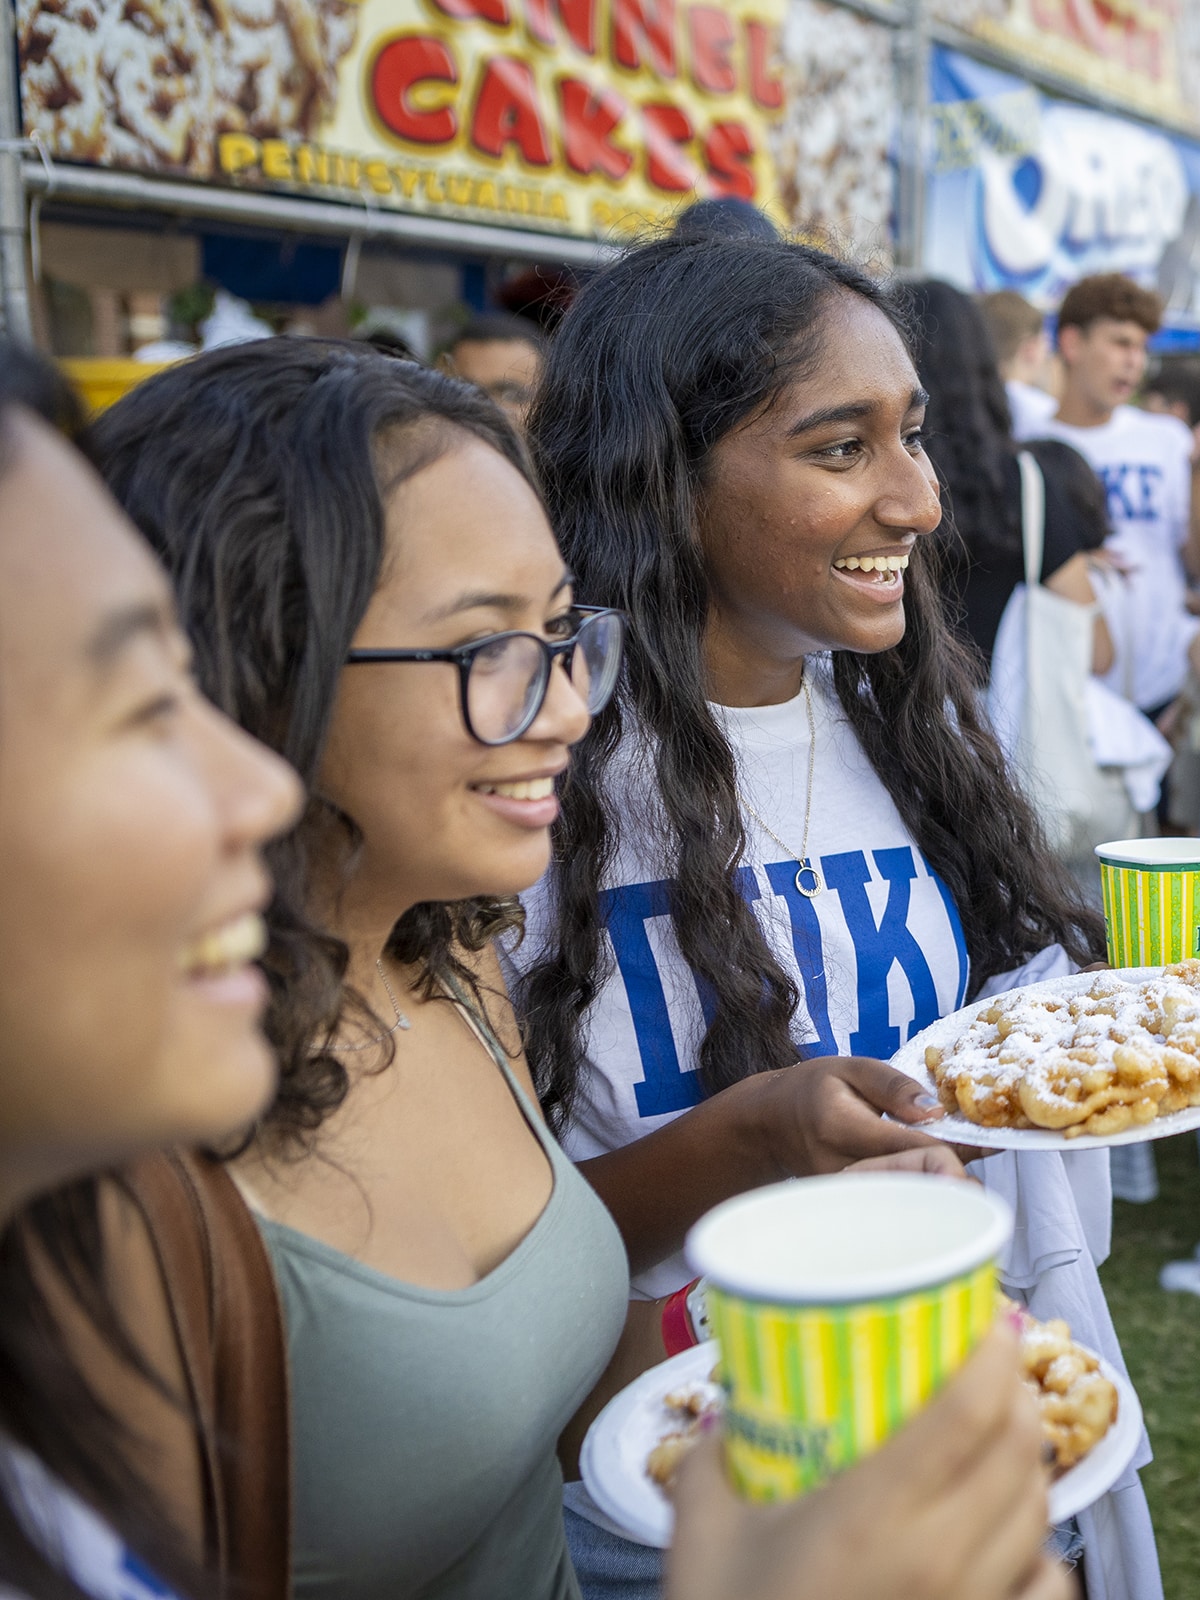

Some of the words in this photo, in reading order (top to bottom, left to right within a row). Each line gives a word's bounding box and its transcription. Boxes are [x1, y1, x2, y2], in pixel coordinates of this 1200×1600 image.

[371, 35, 757, 202] CAKES
[430, 0, 784, 109] NNEL
[219, 132, 570, 221] PENNSYLVANIA
[597, 845, 970, 1118] DUK
